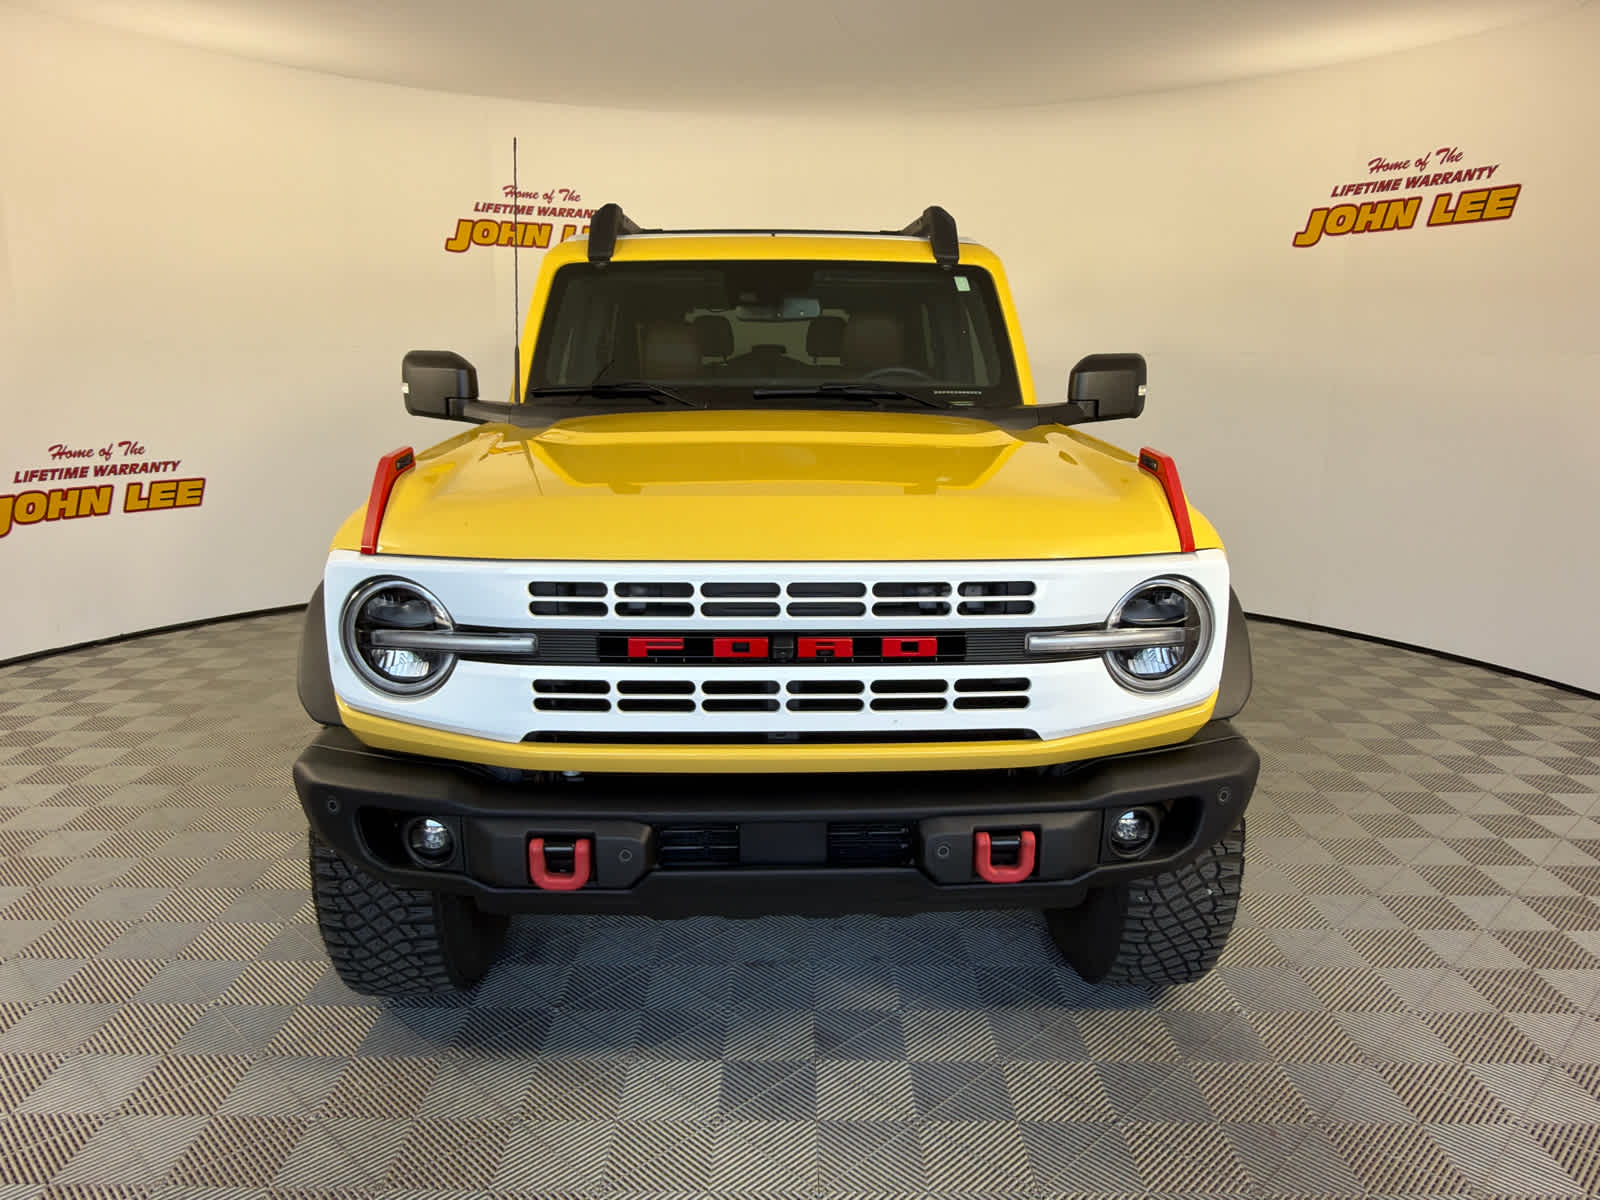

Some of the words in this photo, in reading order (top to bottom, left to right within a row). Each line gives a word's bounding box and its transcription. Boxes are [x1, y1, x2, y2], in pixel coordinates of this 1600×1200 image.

[1368, 157, 1410, 174] Home
[1415, 152, 1431, 172] of
[1436, 147, 1463, 164] The
[1331, 178, 1402, 197] LIFETIME
[1405, 165, 1499, 189] WARRANTY
[503, 185, 539, 200] Home
[543, 190, 555, 203] of
[559, 189, 581, 202] The
[474, 202, 534, 215] LIFETIME
[1293, 197, 1423, 247] JOHN
[1427, 184, 1521, 226] LEE
[445, 219, 553, 252] JOHN
[48, 444, 94, 460] Home
[99, 443, 113, 460] of
[118, 441, 145, 456] The
[14, 466, 89, 483] LIFETIME
[93, 460, 181, 477] WARRANTY
[124, 478, 206, 513] LEE
[627, 636, 938, 658] FORD
